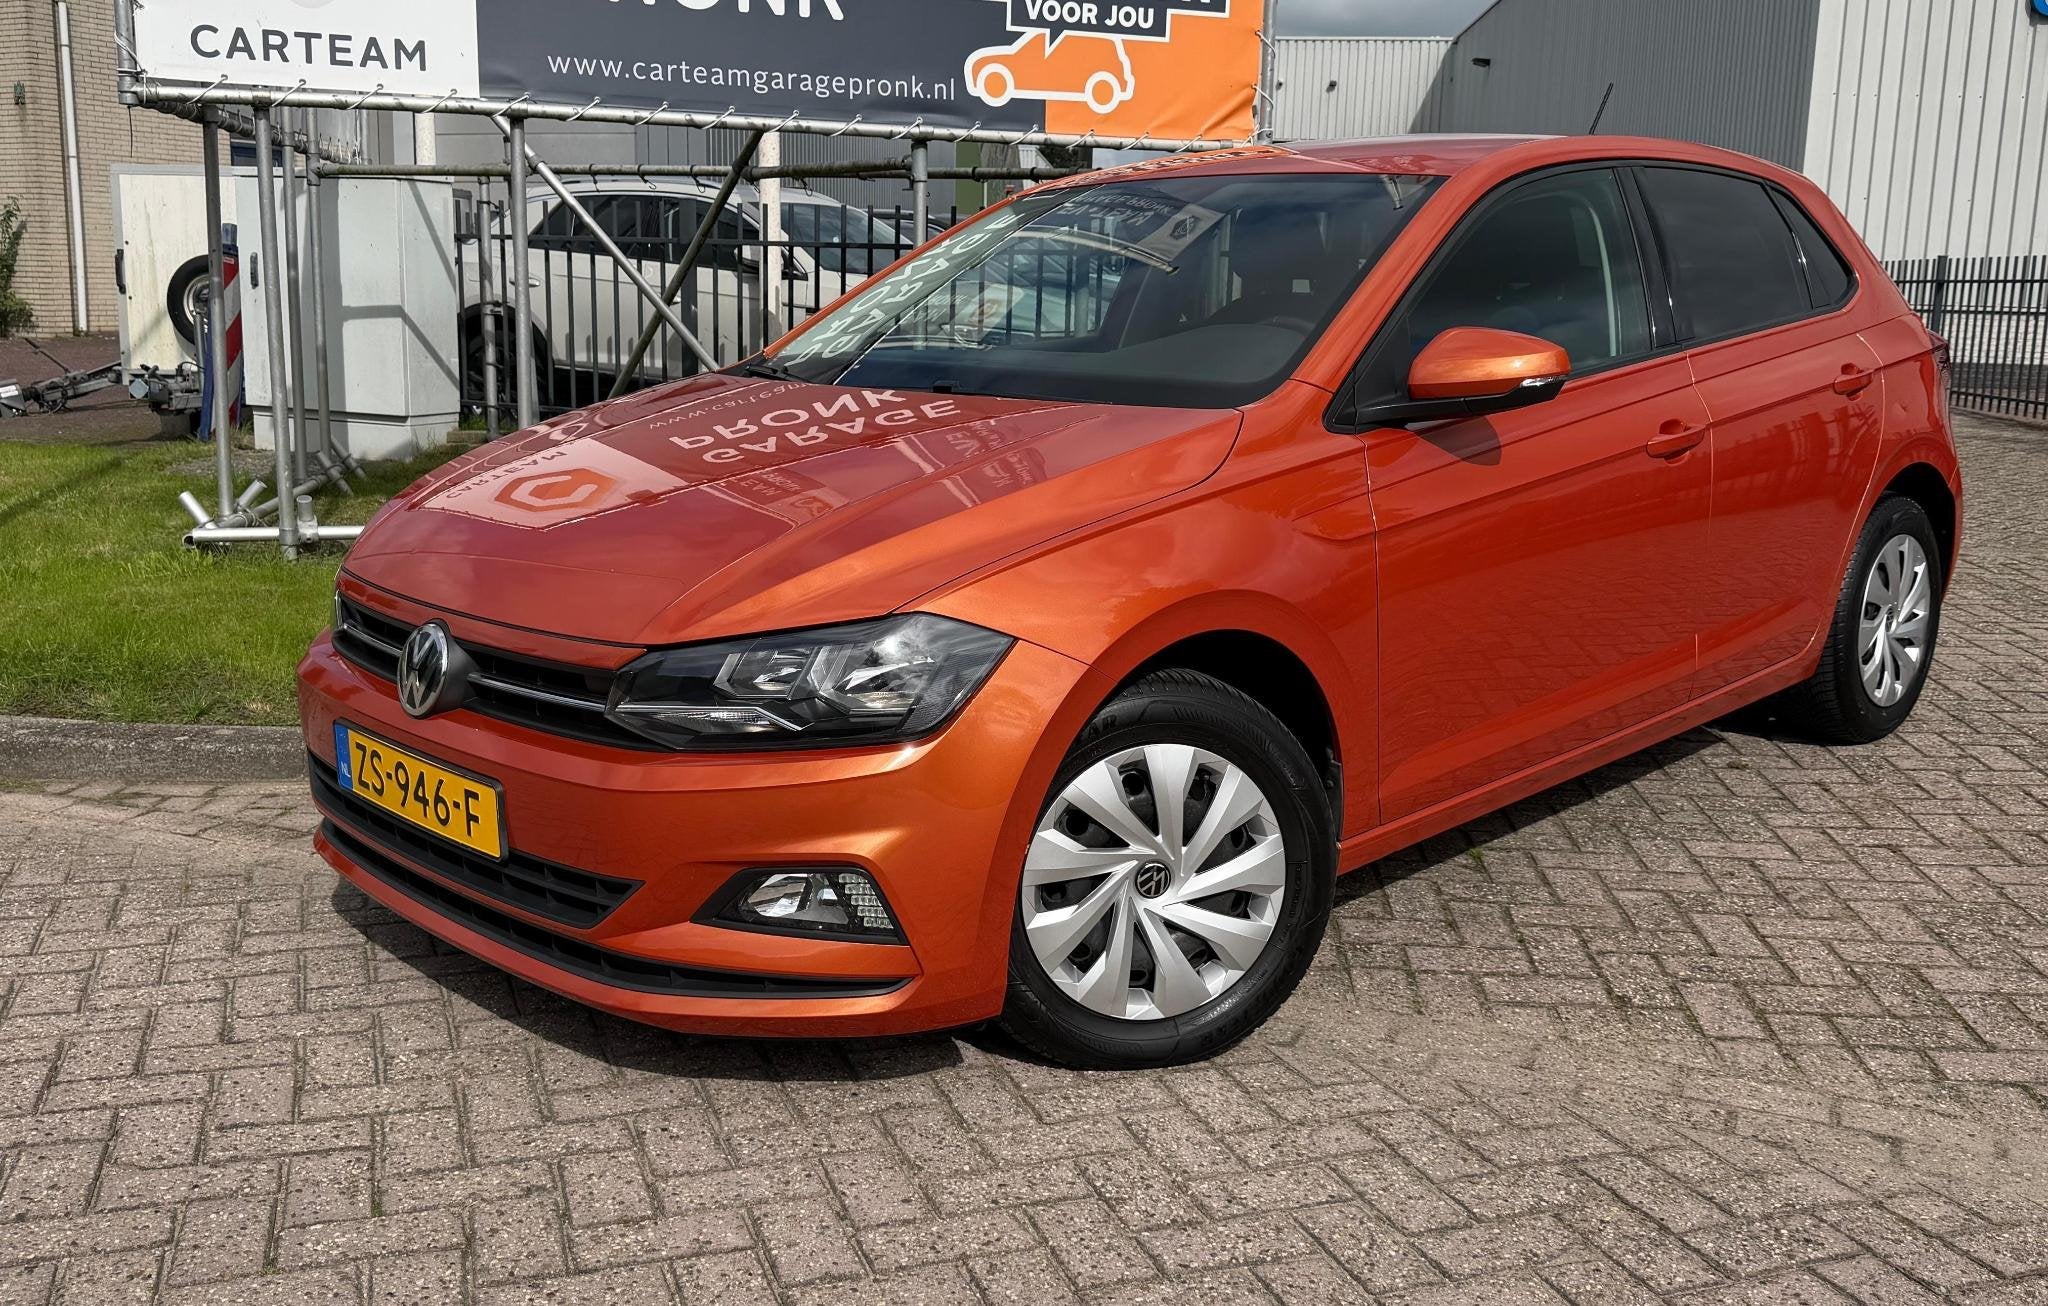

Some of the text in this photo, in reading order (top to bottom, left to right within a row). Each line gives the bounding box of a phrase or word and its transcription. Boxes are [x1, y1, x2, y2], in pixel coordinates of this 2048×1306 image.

[1025, 0, 1154, 29] VOOR JOU
[190, 24, 427, 71] CARTEAM
[547, 54, 957, 101] www.carteamgaragepronk.nl
[340, 760, 351, 778] NL
[355, 743, 480, 837] ZS-946-F
